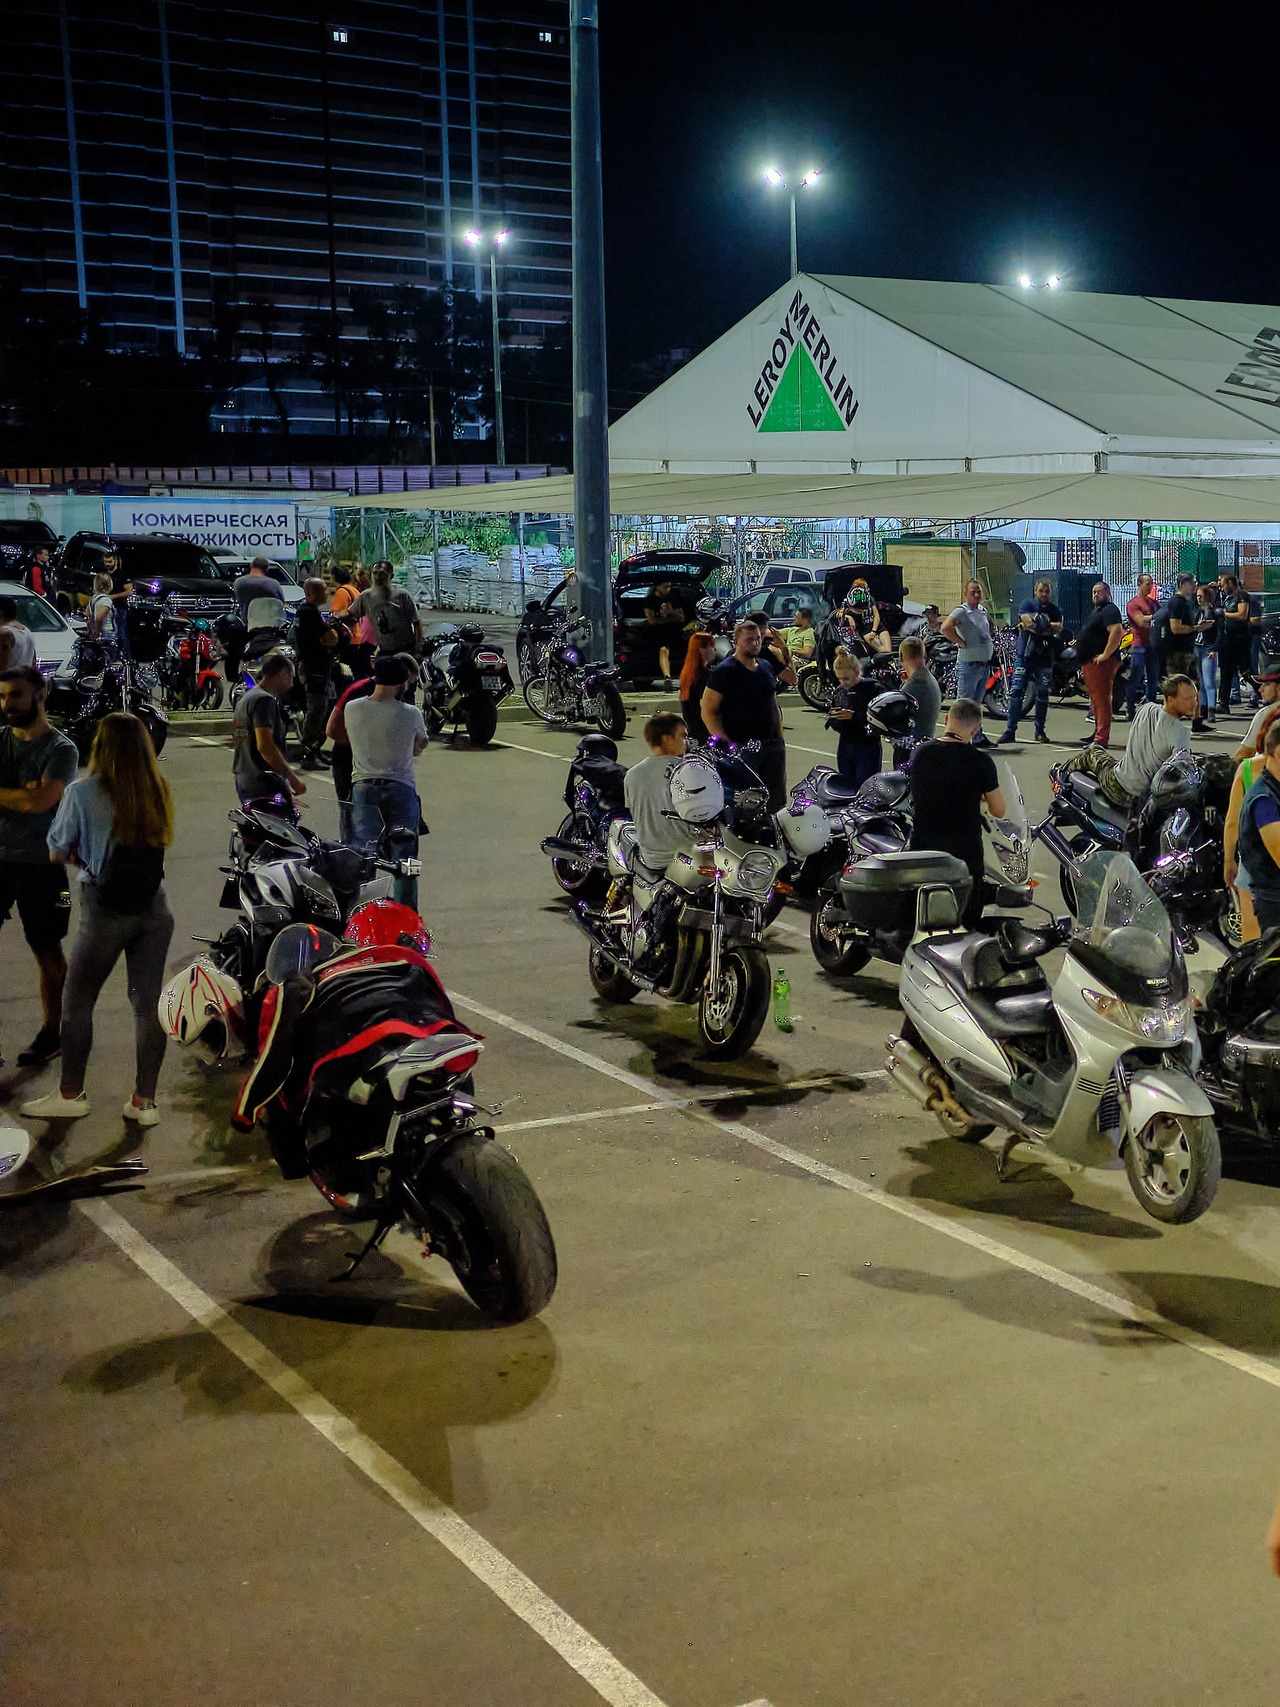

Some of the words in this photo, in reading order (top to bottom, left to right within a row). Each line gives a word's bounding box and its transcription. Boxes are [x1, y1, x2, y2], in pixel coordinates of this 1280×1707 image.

[747, 313, 795, 428] LEROY
[788, 289, 860, 427] MERLIN
[132, 513, 288, 528] КОММЕРЧЕСКАЯ
[178, 533, 295, 547] ИЖИМОСТЬ
